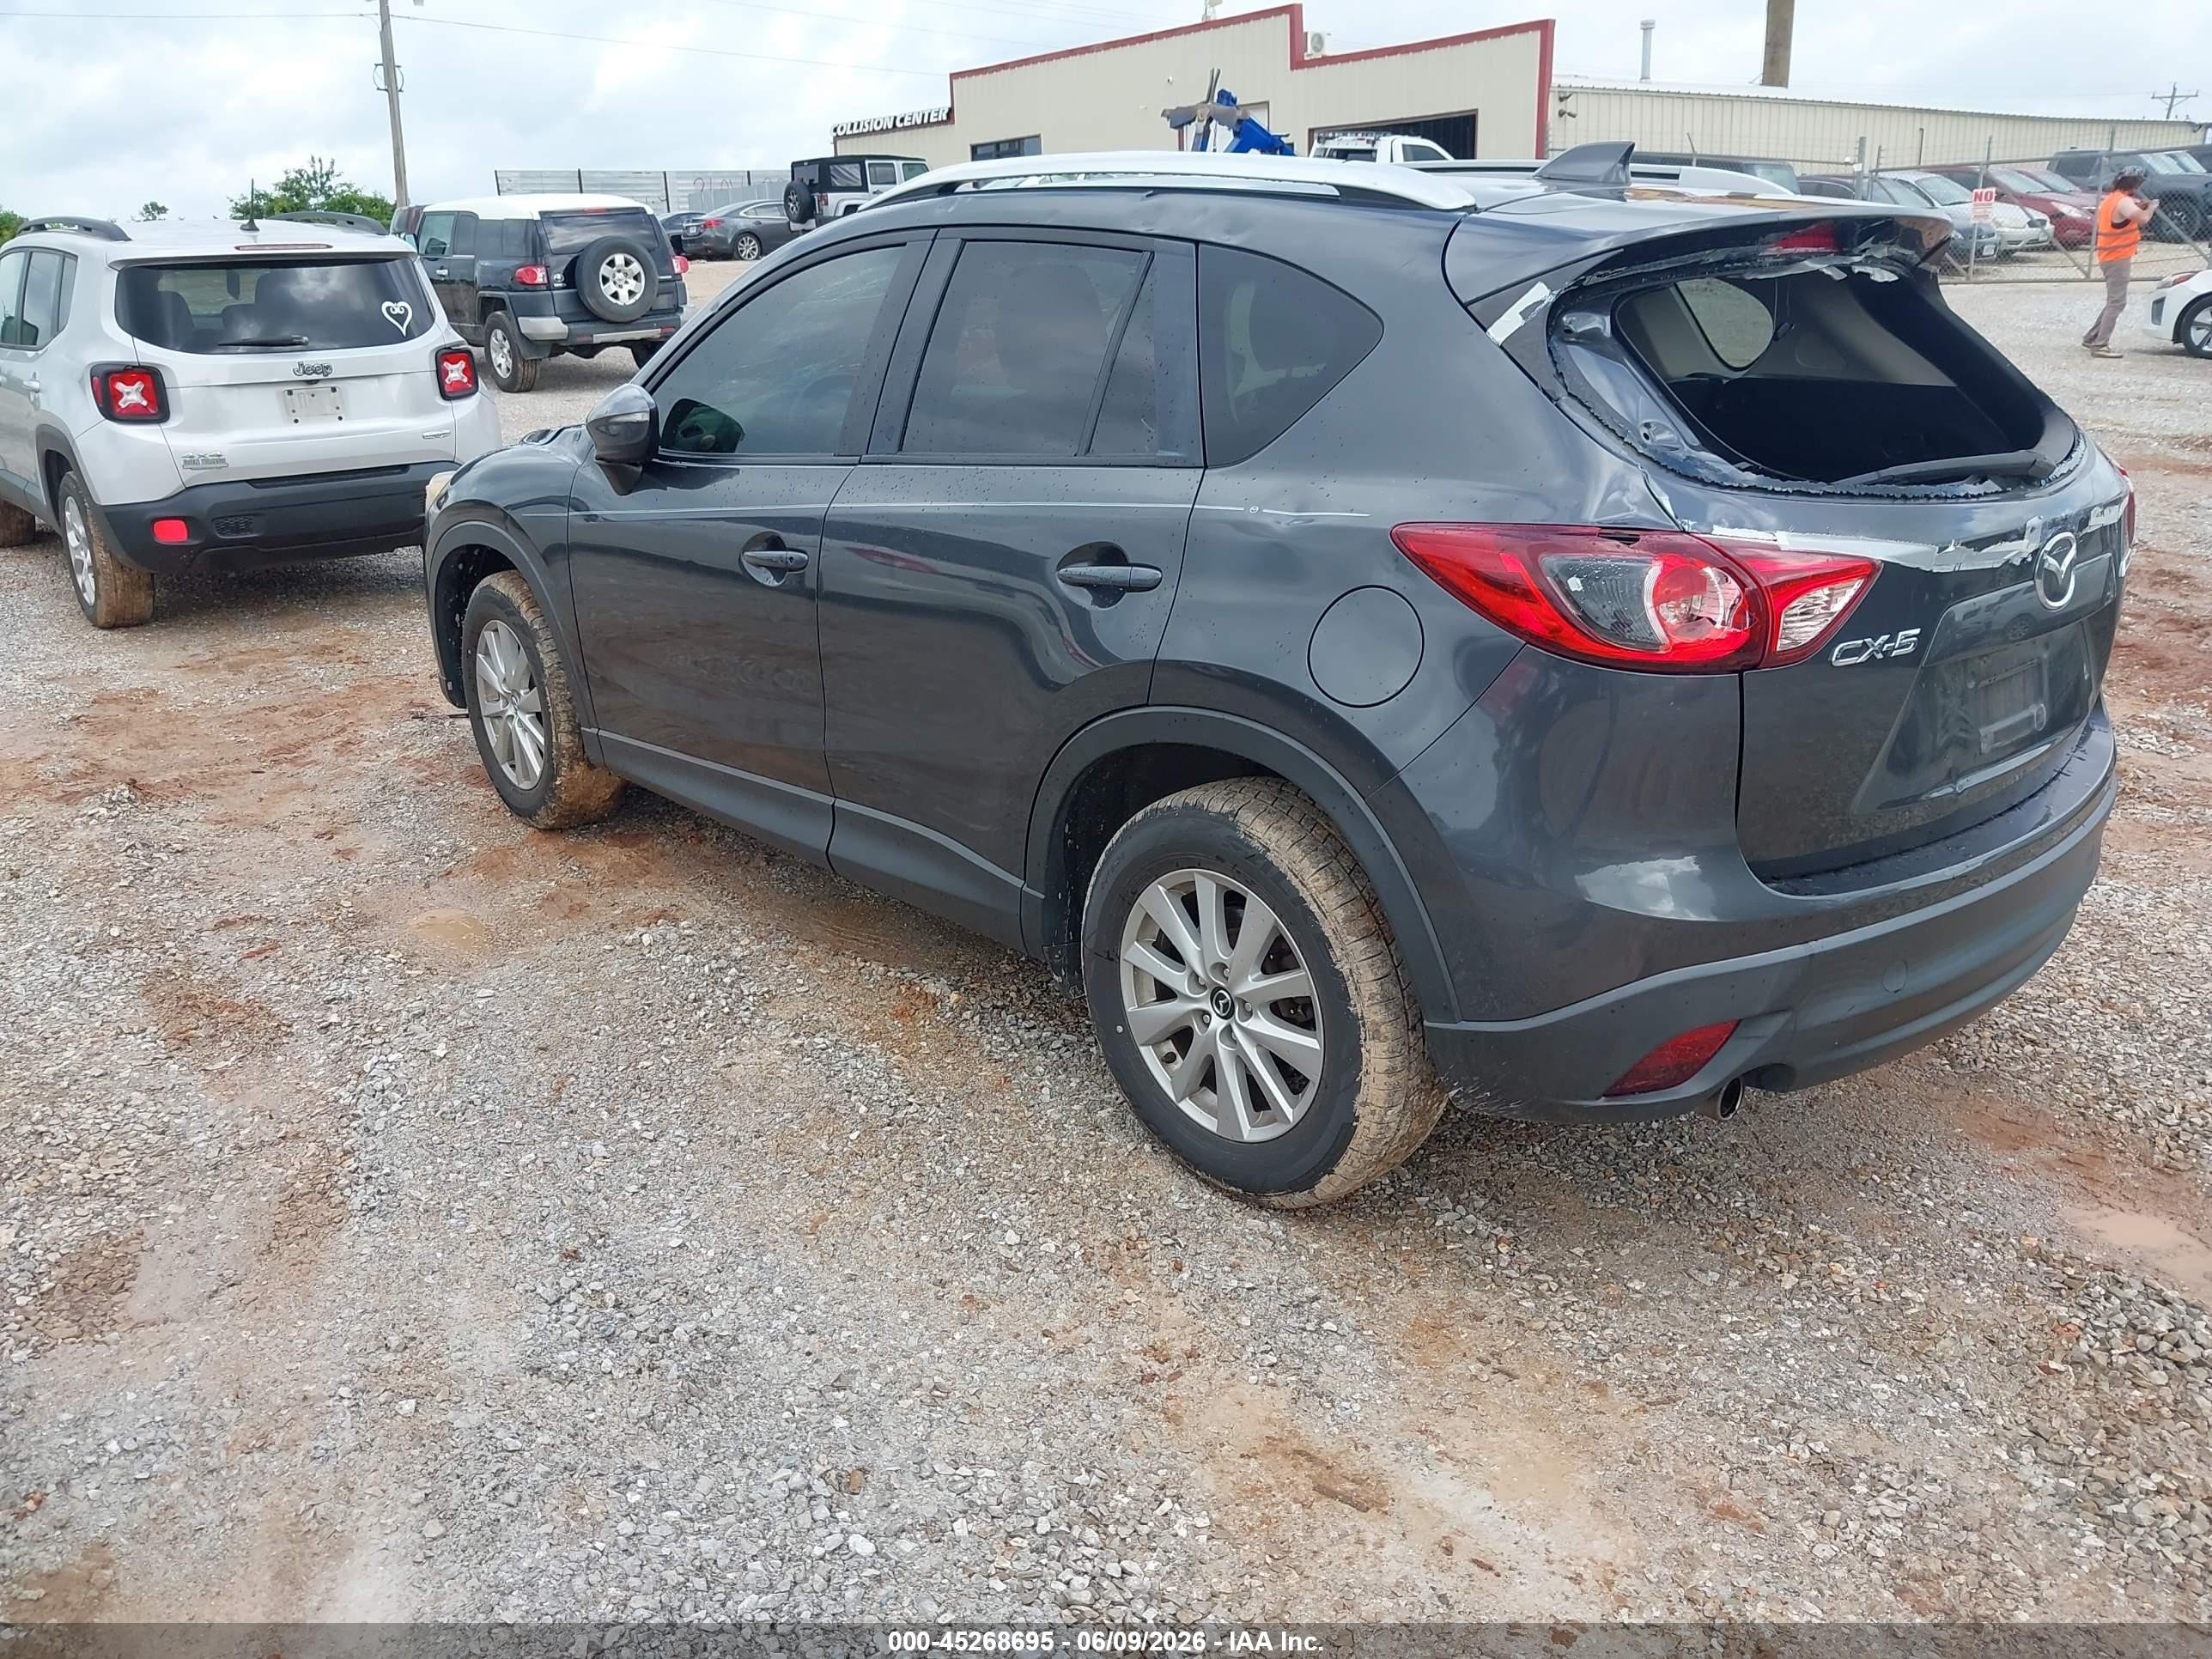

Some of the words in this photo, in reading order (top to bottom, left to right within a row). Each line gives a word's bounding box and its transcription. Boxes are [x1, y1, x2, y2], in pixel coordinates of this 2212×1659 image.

[830, 115, 896, 137] COLLISION
[896, 106, 951, 128] CENTER
[1973, 190, 1994, 203] NO
[293, 361, 333, 377] Jeep
[1830, 627, 1922, 667] CX-5
